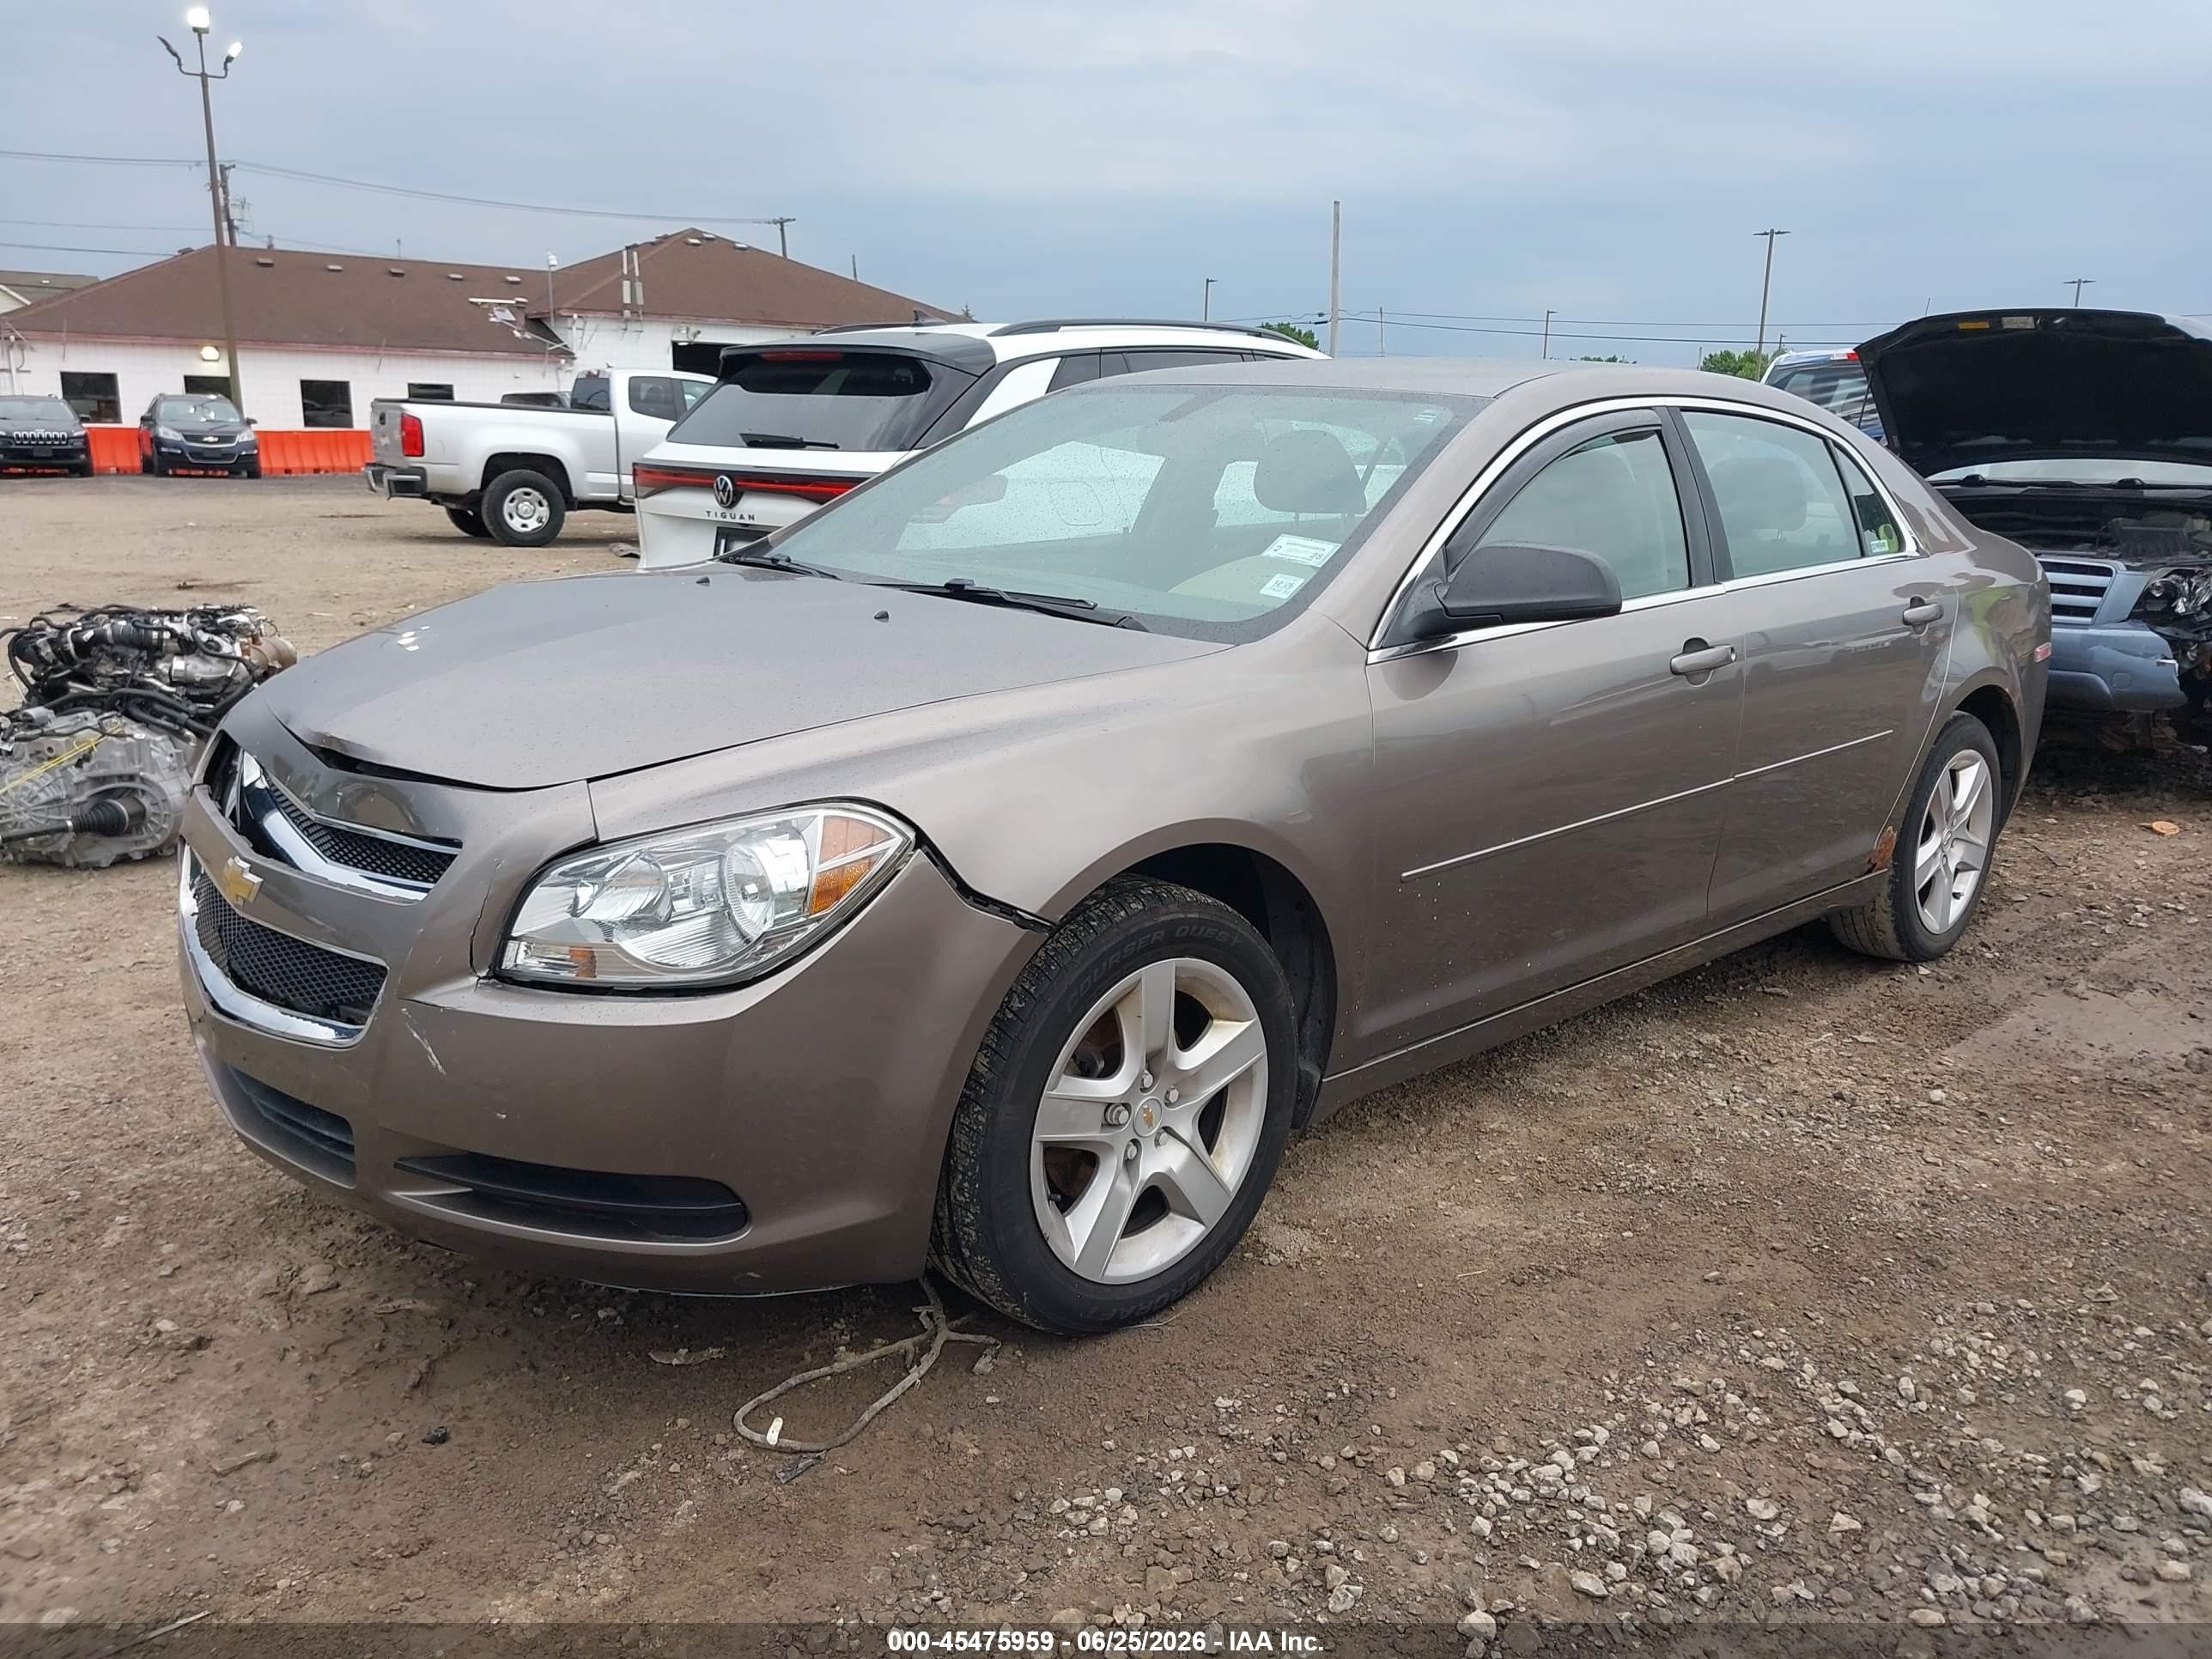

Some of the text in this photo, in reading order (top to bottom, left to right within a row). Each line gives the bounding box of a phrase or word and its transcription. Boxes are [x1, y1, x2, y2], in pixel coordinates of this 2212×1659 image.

[705, 510, 756, 521] TIGUAN
[1066, 924, 1242, 1015] COURSER QUEST
